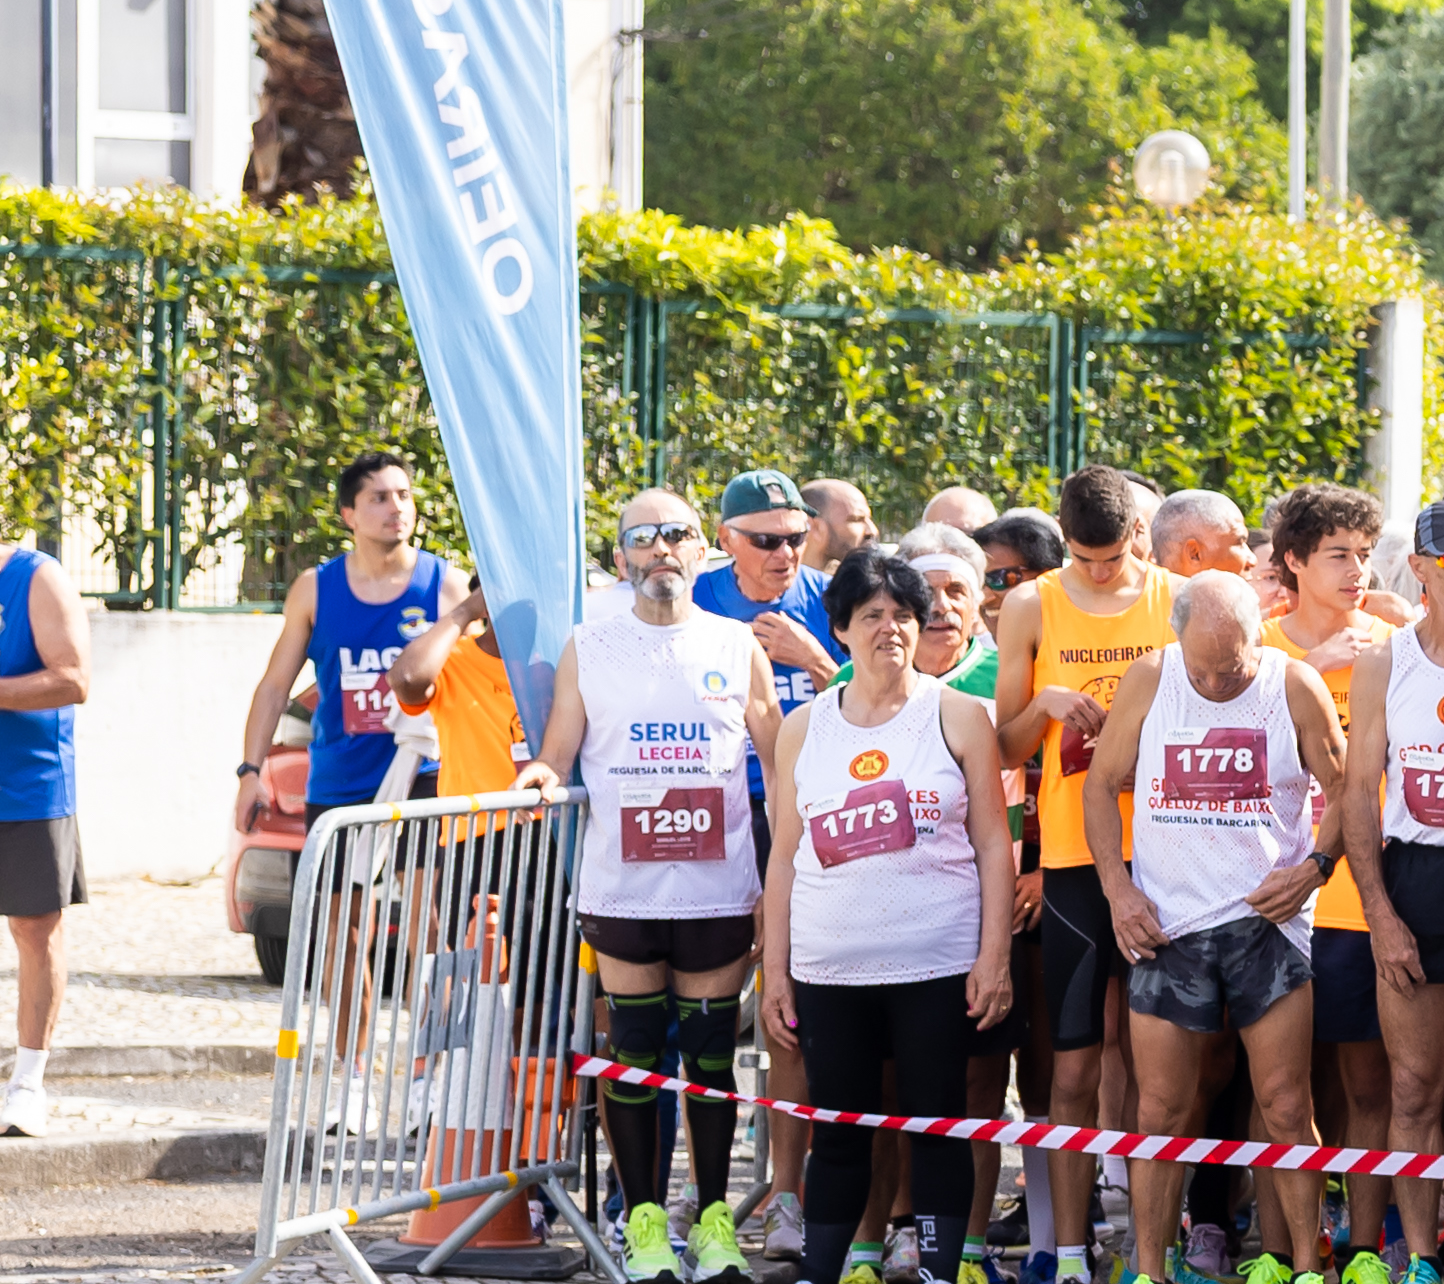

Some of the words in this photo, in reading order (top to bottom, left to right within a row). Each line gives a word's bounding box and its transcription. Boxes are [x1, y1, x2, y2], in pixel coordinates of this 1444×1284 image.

[630, 722, 711, 742] SERUL
[639, 747, 703, 760] LECEIA
[1176, 748, 1254, 773] 1778
[1208, 799, 1228, 813] DE
[634, 808, 711, 835] 1290
[822, 799, 898, 838] 1773
[1151, 814, 1198, 825] FREGUESIA
[1201, 817, 1213, 826] DE
